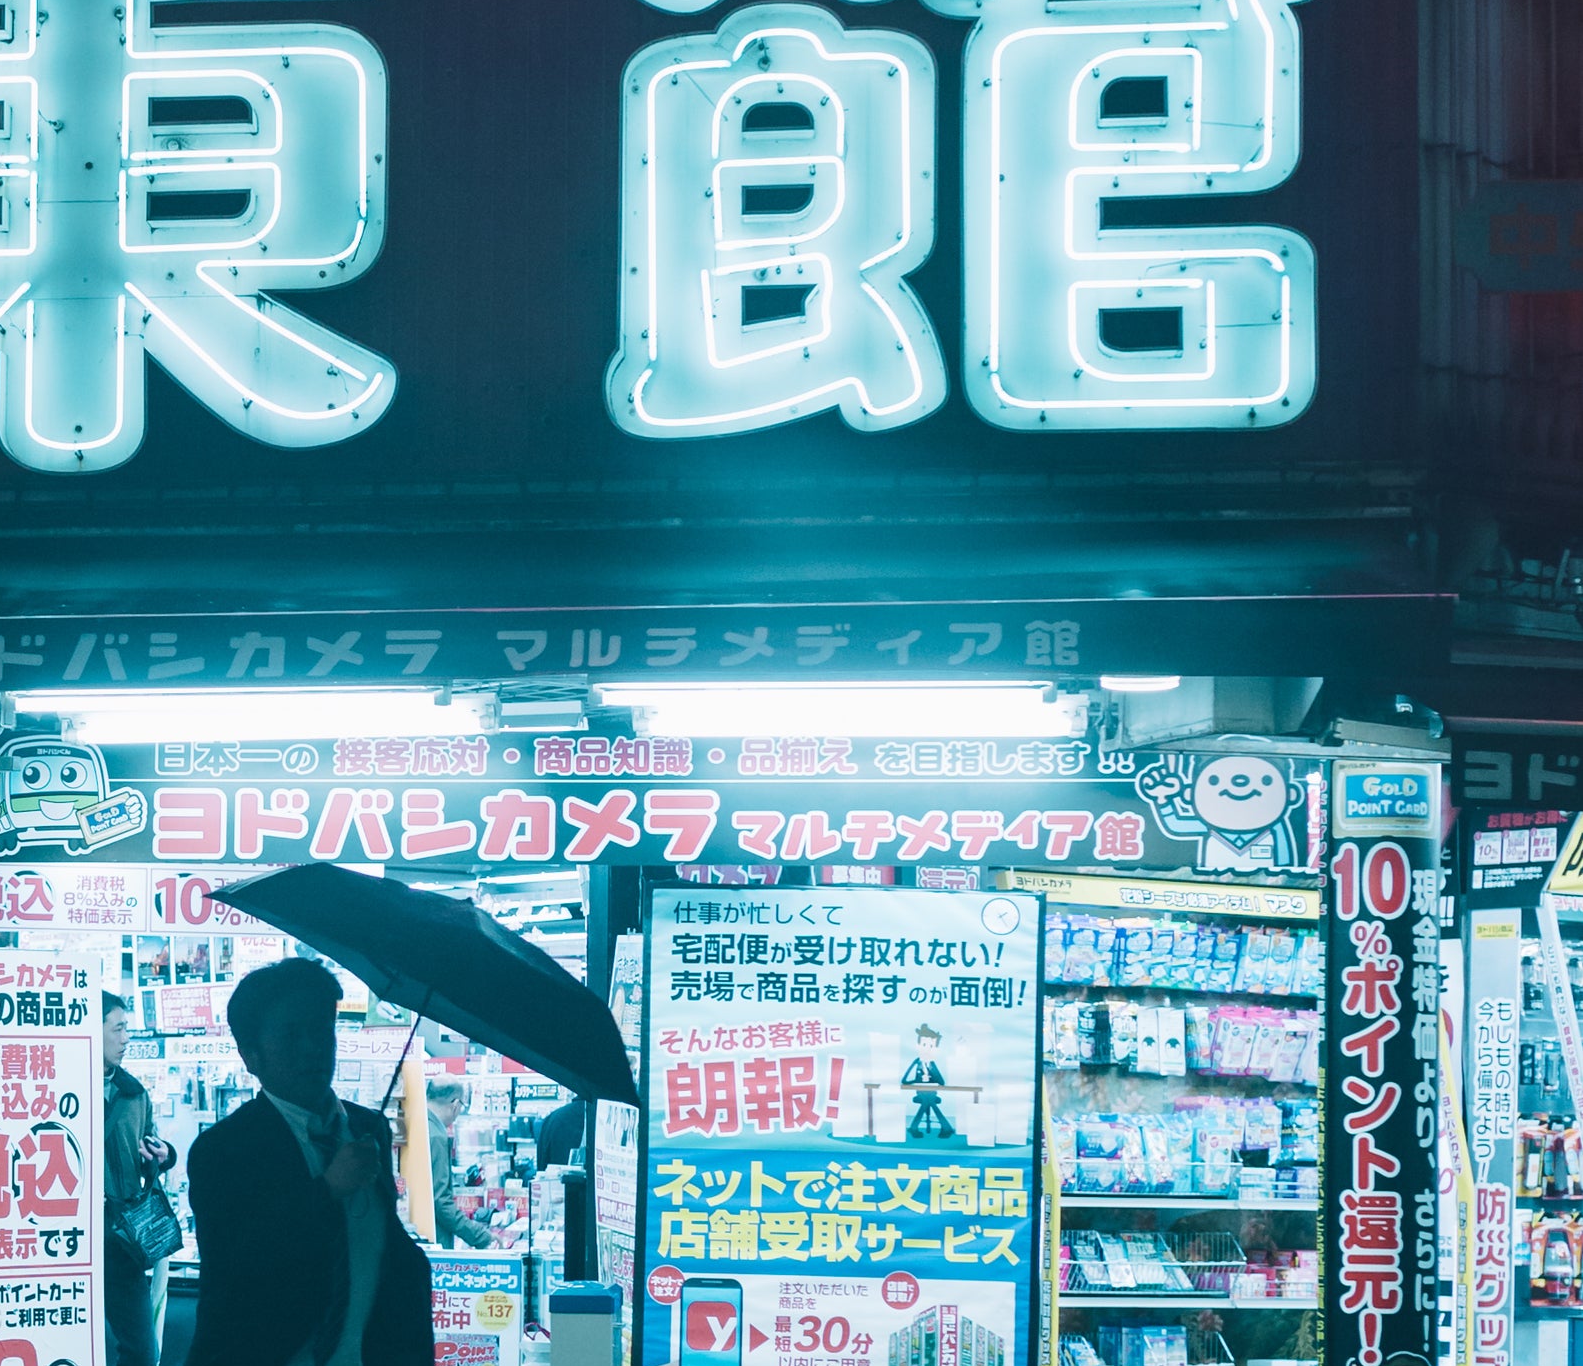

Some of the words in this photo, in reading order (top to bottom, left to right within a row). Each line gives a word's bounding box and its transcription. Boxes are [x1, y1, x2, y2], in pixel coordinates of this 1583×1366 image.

[495, 618, 1082, 673] マルチメディア館
[1362, 776, 1418, 797] GOLD
[1347, 799, 1391, 817] POINT
[1394, 799, 1429, 817] CARD
[151, 785, 721, 862] ヨドバシカメラ
[730, 808, 1145, 861] マルチメディア館
[76, 874, 126, 892] 消費税
[1015, 875, 1073, 890] ヨドバシカメラ
[63, 891, 138, 909] 8%込みの
[1263, 893, 1308, 915] マスク
[66, 908, 134, 926] 特価表示
[672, 900, 845, 927] 仕事が忙しくて
[670, 932, 1005, 969] 宅配便が受け取れない!
[670, 970, 1029, 1009] 売場で商品を探すのが面倒!
[658, 1019, 844, 1056] そんなお客様に
[1494, 1000, 1514, 1136] もしもの時に
[663, 1054, 847, 1138] 朗報!
[1475, 1000, 1495, 1184] 今から備えよう!
[653, 1160, 1030, 1218] ネットで注文商品
[654, 1212, 1020, 1267] 店舗受取サービス
[649, 1275, 683, 1288] ネットで
[652, 1285, 681, 1299] 注文!
[778, 1281, 870, 1298] 注文いただいた
[431, 1290, 471, 1310] 料にて
[778, 1296, 818, 1310] 商品を
[4, 1306, 87, 1328] ご利用で更に
[432, 1309, 471, 1331] 布中
[477, 1303, 514, 1320] No.137
[792, 1314, 875, 1356] 30分
[434, 1341, 495, 1361] POINT
